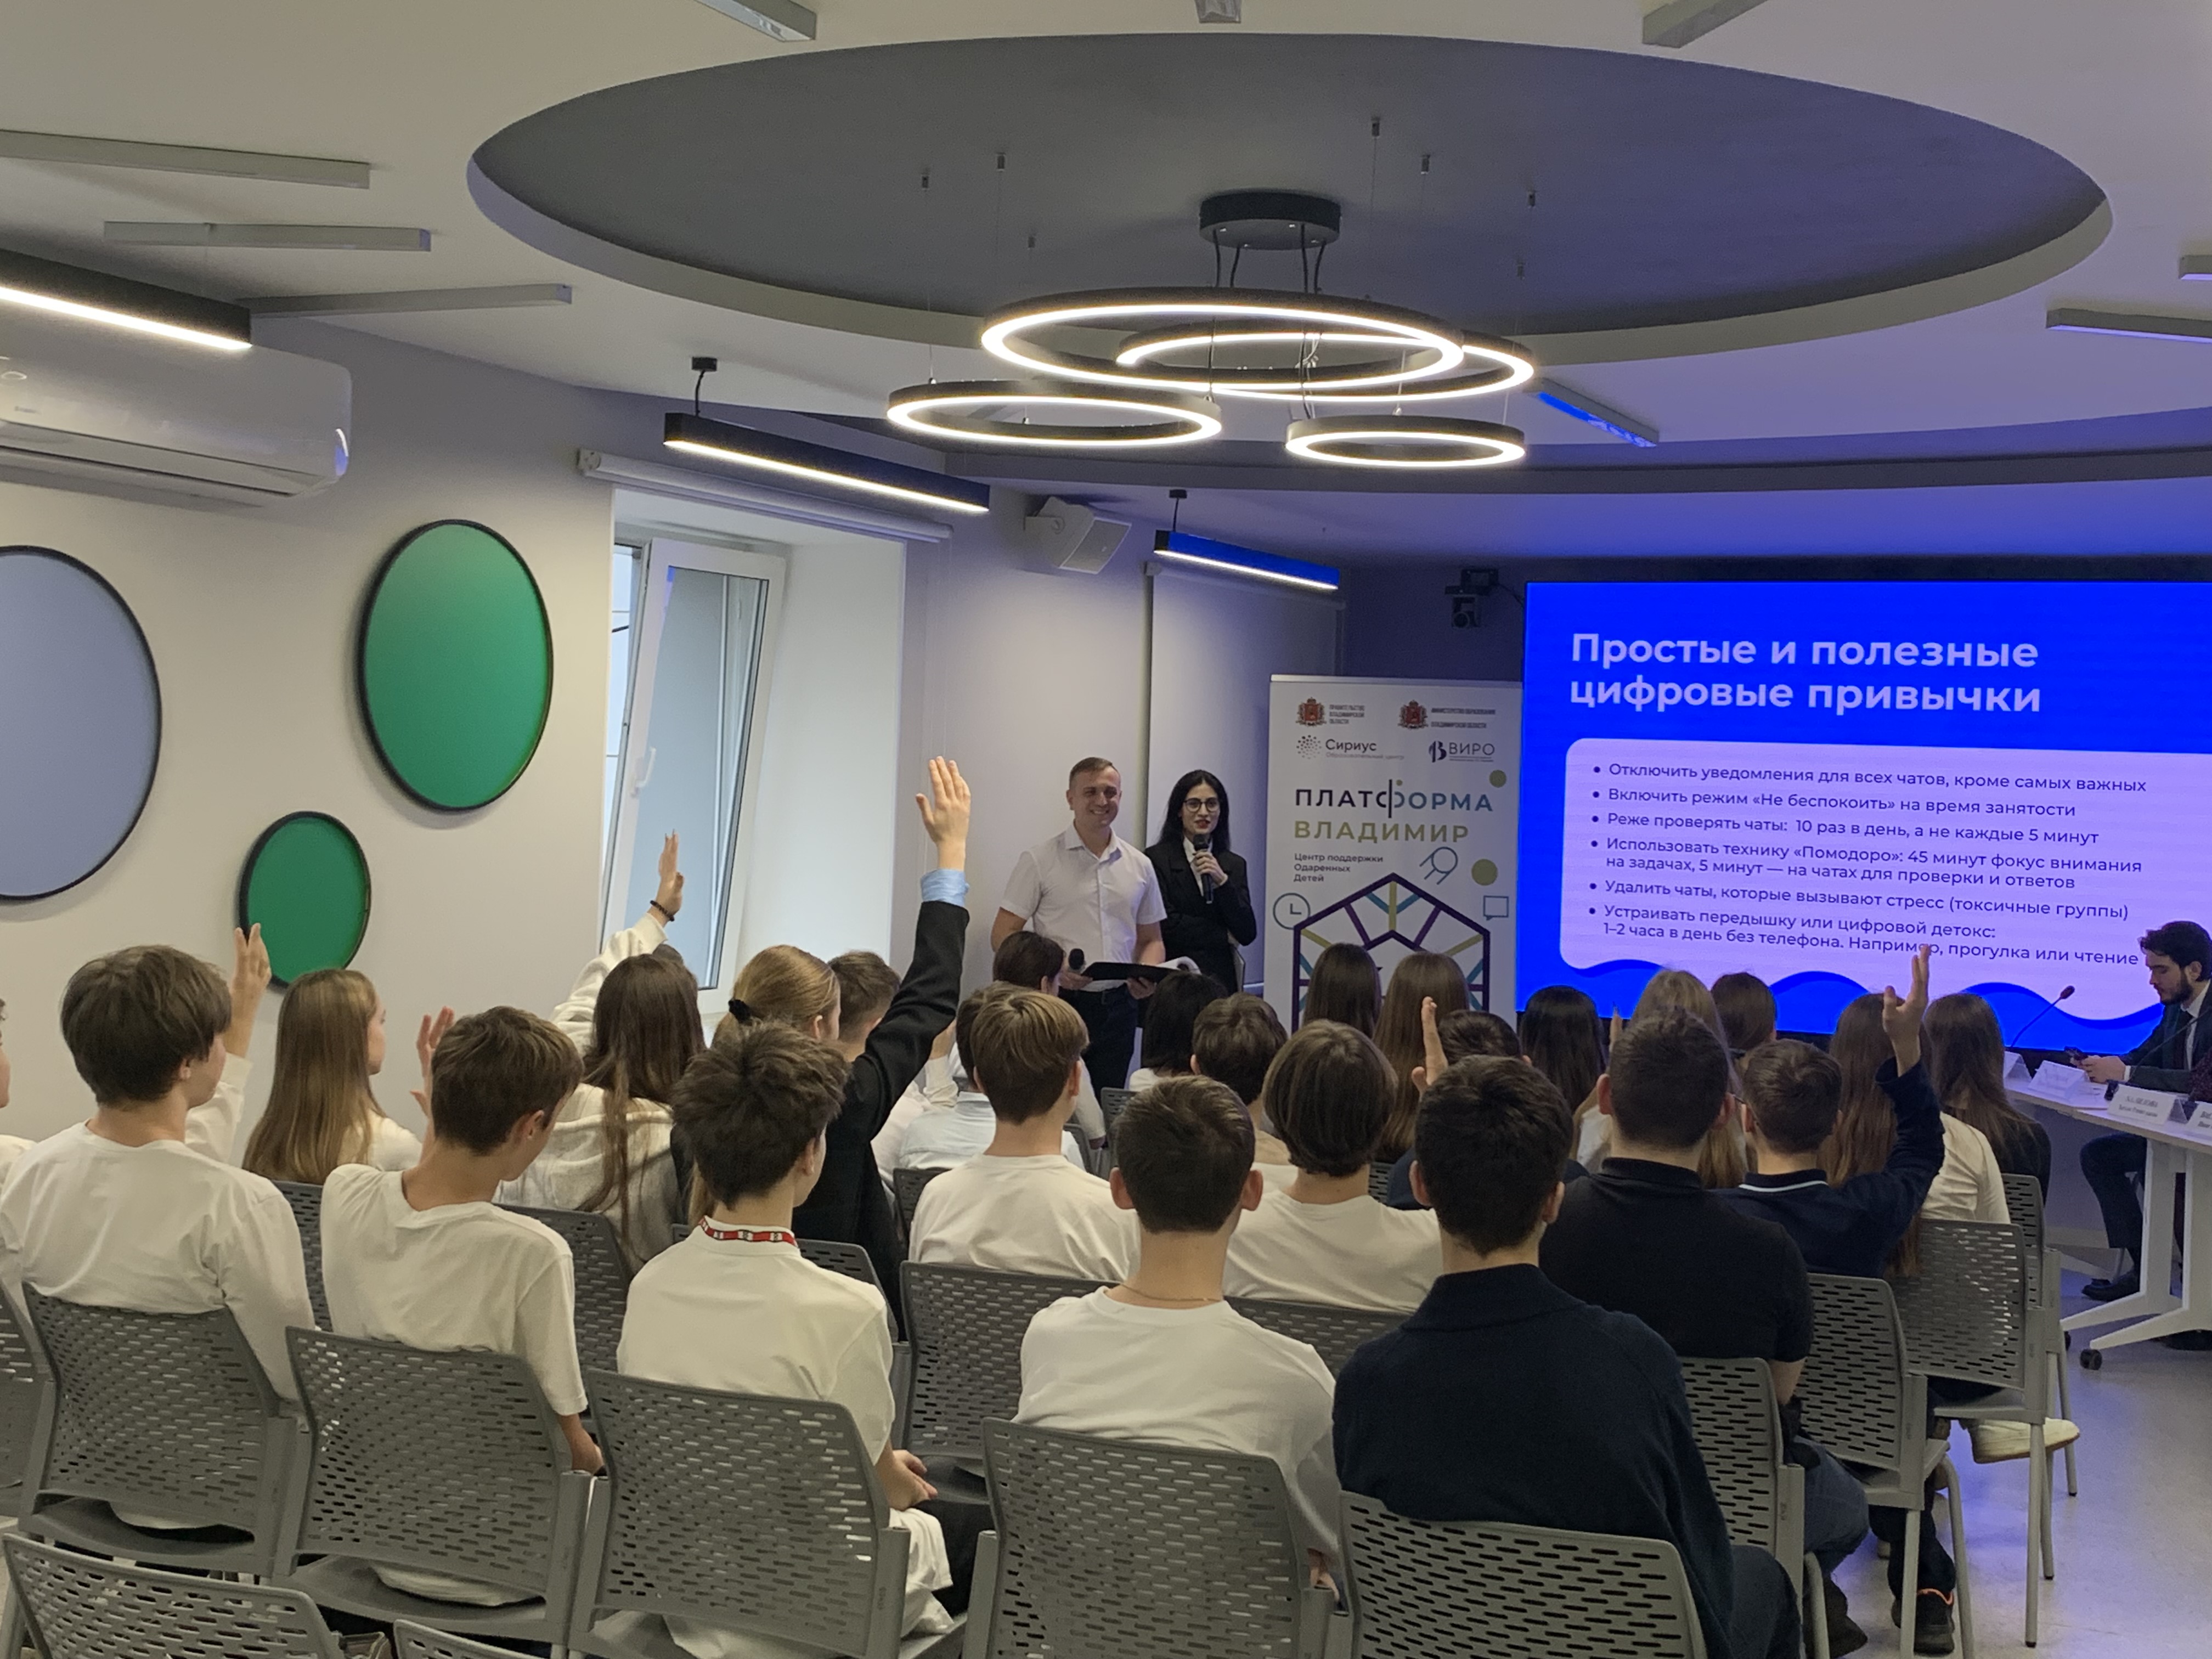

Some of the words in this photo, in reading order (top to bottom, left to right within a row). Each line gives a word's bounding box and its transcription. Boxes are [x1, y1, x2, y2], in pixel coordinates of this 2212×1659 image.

[1573, 634, 1756, 669] Простые
[1771, 642, 1796, 663] и
[1813, 642, 2038, 667] полезные
[1571, 675, 1793, 712] цифровые
[1809, 685, 2040, 715] привычки
[1325, 738, 1377, 753] Сириус
[1449, 742, 1495, 756] ВИРО
[1609, 763, 1698, 777] Отключить
[1700, 768, 1814, 781] уведомления
[1818, 772, 1849, 783] для
[1854, 773, 1893, 784] всех
[1897, 774, 1949, 788] чатов,
[1955, 776, 2010, 789] кроме
[2015, 778, 2071, 789] самых
[2076, 780, 2146, 792] важных
[1295, 779, 1493, 819] ПЛАТФОРМА
[1609, 788, 1688, 802] Включить
[1692, 793, 1748, 806] режим
[1752, 793, 1783, 806] «Не
[1788, 793, 1895, 809] беспокоить»
[1900, 800, 1920, 811] на
[1926, 802, 1980, 815] время
[1985, 803, 2075, 816] занятости
[1294, 821, 1469, 844] ВЛАДИМИР
[1608, 812, 1650, 826] Реже
[1654, 817, 1741, 831] проверять
[1744, 820, 1787, 831] чаты:
[1796, 820, 1813, 832] 10
[1817, 823, 1846, 836] раз
[1851, 825, 1860, 834] в
[1864, 825, 1910, 838] день,
[1914, 827, 1923, 837] а
[1929, 827, 1950, 838] не
[1955, 828, 2024, 842] каждые
[2028, 828, 2039, 842] 5
[2044, 832, 2100, 846] минут
[1294, 853, 1325, 862] Центр
[1327, 855, 1384, 863] поддержки
[1294, 863, 1351, 872] Одаренных
[1607, 837, 1719, 854] Использовать
[1723, 844, 1790, 860] технику
[1793, 845, 1903, 864] «Помодоро»:
[1908, 850, 1928, 864] 45
[1933, 854, 1987, 868] минут
[1991, 853, 2045, 871] фокус
[2051, 859, 2141, 872] внимания
[1293, 874, 1324, 882] Детей
[1606, 857, 1624, 867] на
[1629, 859, 1695, 872] задачах,
[1699, 859, 1708, 872] 5
[1713, 862, 1763, 876] минут
[1788, 866, 1807, 876] на
[1812, 867, 1857, 878] чатах
[1860, 869, 1892, 881] для
[1898, 871, 1983, 886] проверки
[1989, 875, 2000, 885] и
[2005, 876, 2075, 888] ответов
[1605, 880, 1671, 895] Удалить
[1674, 886, 1717, 899] чаты,
[1721, 888, 1791, 902] которые
[1796, 892, 1883, 905] вызывают
[1886, 896, 1944, 910] стресс
[1950, 896, 2051, 915] (токсичные
[2056, 905, 2128, 922] группы)
[1604, 905, 1695, 921] Устраивать
[1700, 912, 1797, 930] передышку
[1801, 918, 1832, 929] или
[1838, 918, 1926, 934] цифровой
[1931, 925, 1995, 938] детокс:
[1629, 926, 1664, 938] часа
[1669, 929, 1678, 938] в
[1681, 929, 1722, 941] день
[1726, 929, 1754, 943] без
[1758, 933, 1844, 949] телефона.
[1949, 945, 2030, 960] прогулка
[2036, 950, 2069, 961] или
[2074, 952, 2138, 965] чтение
